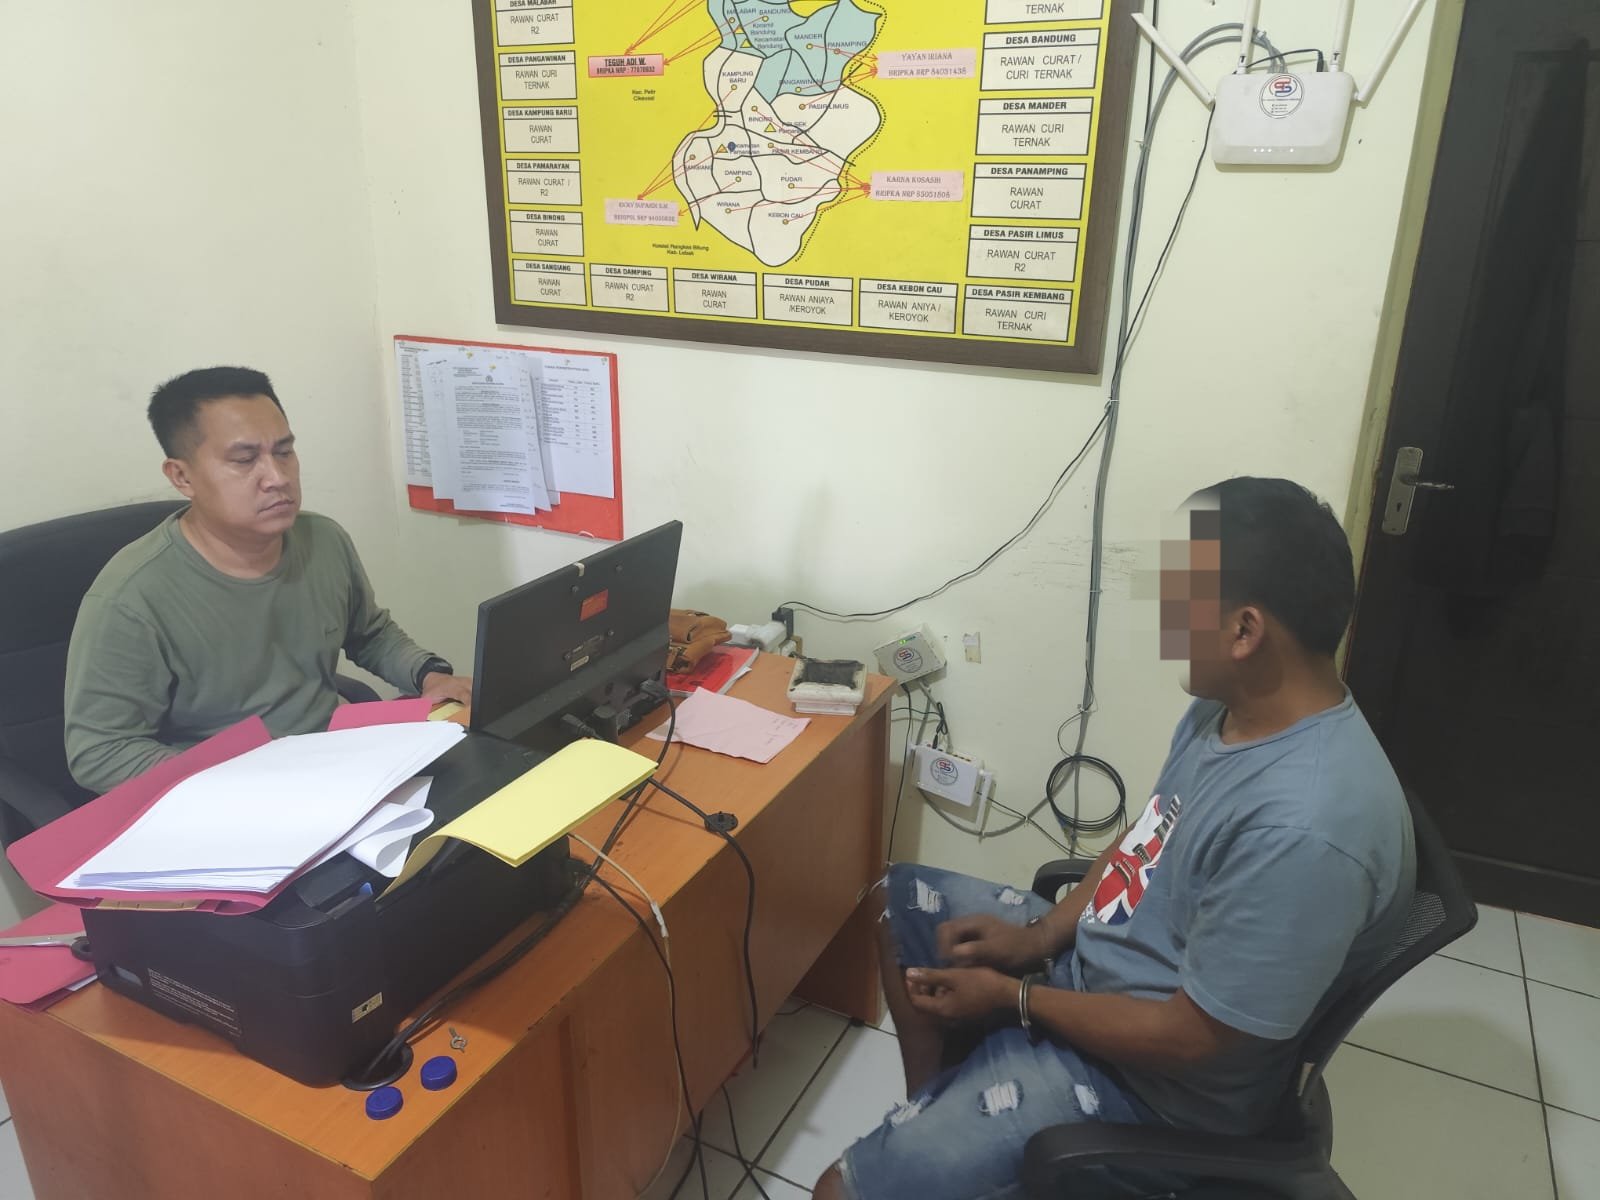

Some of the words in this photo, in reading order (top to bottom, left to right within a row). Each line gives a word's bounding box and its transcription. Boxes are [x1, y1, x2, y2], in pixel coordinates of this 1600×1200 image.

[1026, 3, 1064, 14] TERNAK
[510, 16, 533, 24] RAWAN
[537, 13, 559, 22] CURAT
[531, 26, 540, 35] R2
[1006, 36, 1030, 44] DESA
[1031, 34, 1076, 43] BANDUNG
[524, 54, 566, 63] PANGAWINAN
[1000, 56, 1034, 66] RAWAN
[1043, 54, 1076, 65] CURAT
[515, 71, 539, 79] RAWAN
[541, 70, 557, 78] CURI
[1006, 70, 1029, 80] CURI
[1035, 69, 1072, 79] TERNAK
[524, 81, 550, 90] TERNAK
[1003, 102, 1027, 110] DESA
[1028, 102, 1067, 110] MANDER
[529, 125, 552, 133] RAWAN
[1002, 124, 1035, 133] RAWAN
[1041, 124, 1064, 133] CURI
[530, 135, 552, 144] CURAT
[1013, 138, 1050, 147] TERNAK
[991, 167, 1014, 175] DESA
[1015, 167, 1068, 176] PANAMPING
[518, 178, 541, 186] RAWAN
[543, 178, 565, 186] CURAT
[540, 188, 549, 196] R2
[1010, 187, 1044, 196] RAWAN
[1010, 200, 1041, 210] CURAT
[535, 228, 559, 237] RAWAN
[984, 229, 1005, 237] DESA
[1008, 230, 1034, 239] PASIR
[1036, 230, 1064, 239] LIMUS
[538, 238, 559, 247] CURAT
[987, 249, 1020, 260] RAWAN
[1024, 250, 1056, 261] CURAT
[542, 264, 571, 272] SANGIANG
[621, 268, 652, 276] DAMPING
[1014, 262, 1026, 273] R2
[709, 273, 737, 282] WIRANA
[538, 278, 560, 287] RAWAN
[605, 282, 628, 291] RAWAN
[631, 283, 654, 292] CURAT
[805, 279, 830, 287] PUDAR
[541, 288, 561, 297] CURAT
[877, 283, 895, 291] DESA
[897, 284, 924, 293] KEBON
[926, 286, 942, 294] CAU
[626, 292, 635, 301] R2
[702, 290, 727, 298] RAWAN
[972, 288, 992, 297] DESA
[994, 290, 1020, 299] PASIR
[1022, 291, 1065, 301] KEMBANG
[779, 293, 806, 303] RAWAN
[808, 295, 834, 305] ANIAYA
[703, 300, 727, 309] CURAT
[878, 300, 909, 310] RAWAN
[912, 301, 937, 312] ANIYA
[788, 304, 826, 315] /KEROYOK
[985, 308, 1018, 319] RAWAN
[1024, 310, 1046, 320] CURI
[889, 311, 929, 322] KEROYOK
[997, 321, 1032, 332] TERNAK
